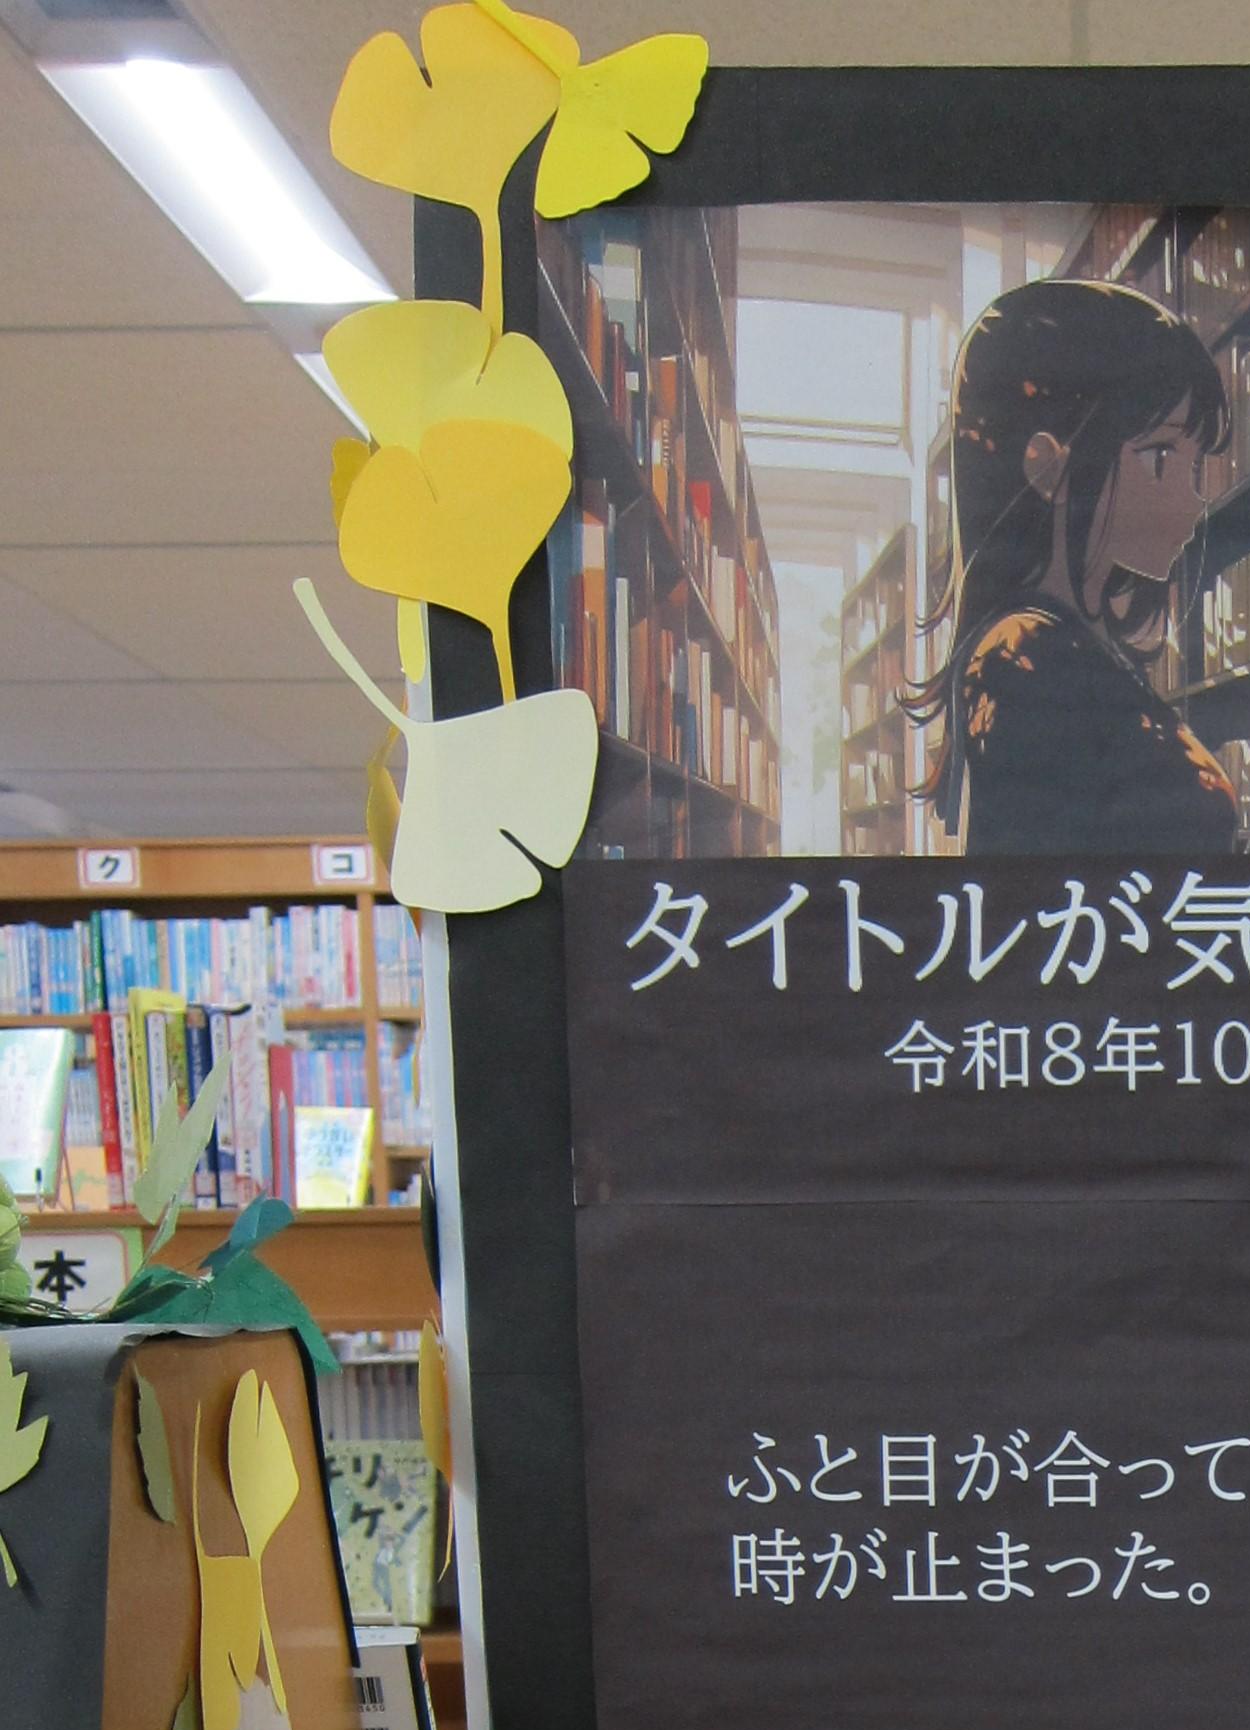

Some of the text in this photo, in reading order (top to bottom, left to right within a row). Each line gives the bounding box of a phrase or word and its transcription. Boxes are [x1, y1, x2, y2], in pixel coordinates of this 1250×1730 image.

[99, 854, 120, 878] ク
[333, 852, 355, 874] コ
[34, 1251, 86, 1301] 本
[733, 1528, 1210, 1604] 時が止まった。
